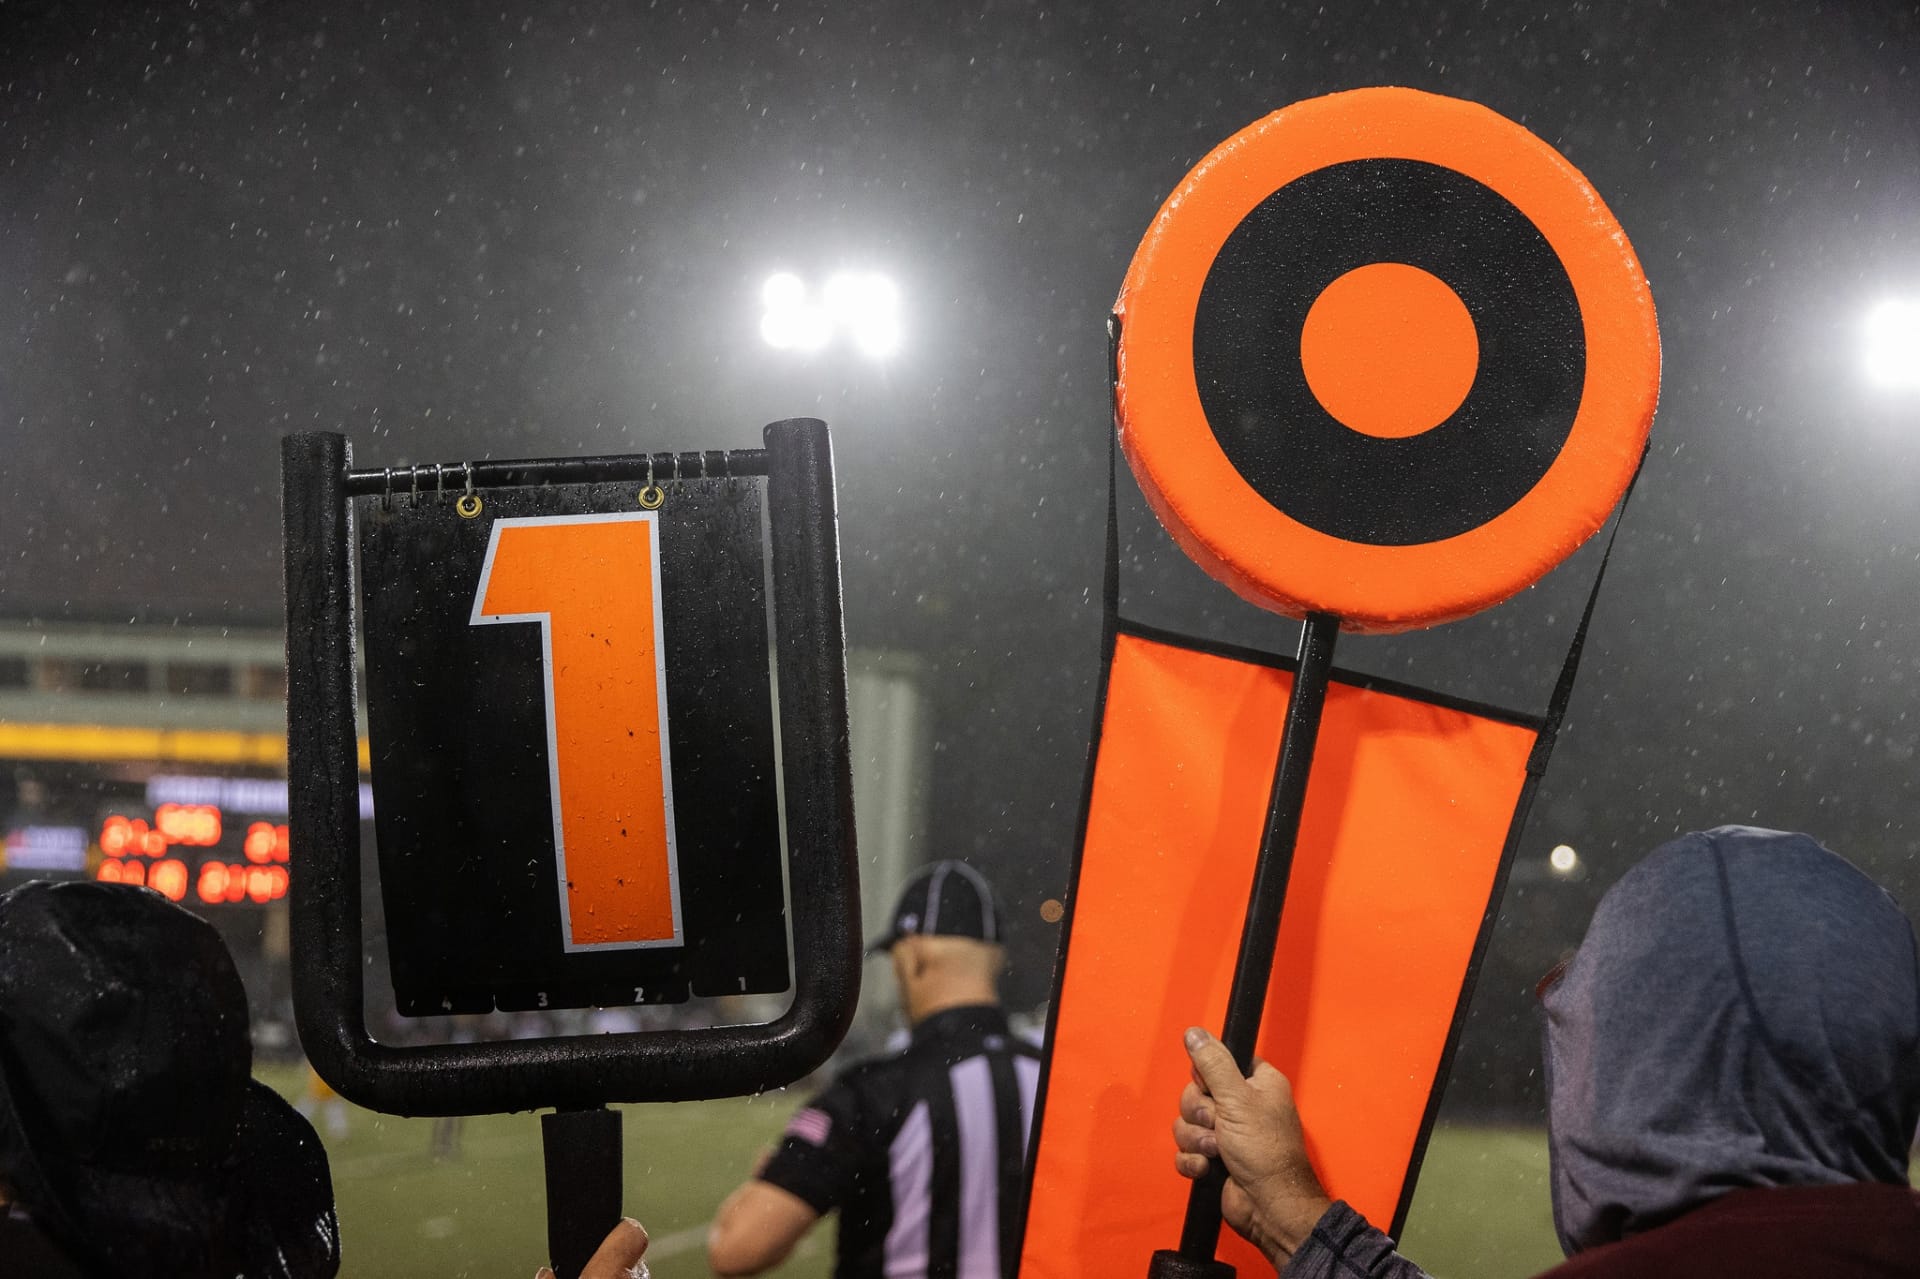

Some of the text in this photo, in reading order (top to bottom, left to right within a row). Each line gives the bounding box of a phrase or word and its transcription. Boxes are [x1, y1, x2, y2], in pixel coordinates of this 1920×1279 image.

[469, 511, 684, 953] 1
[738, 976, 746, 991] 1
[537, 992, 548, 1007] 3
[634, 987, 645, 1002] 2
